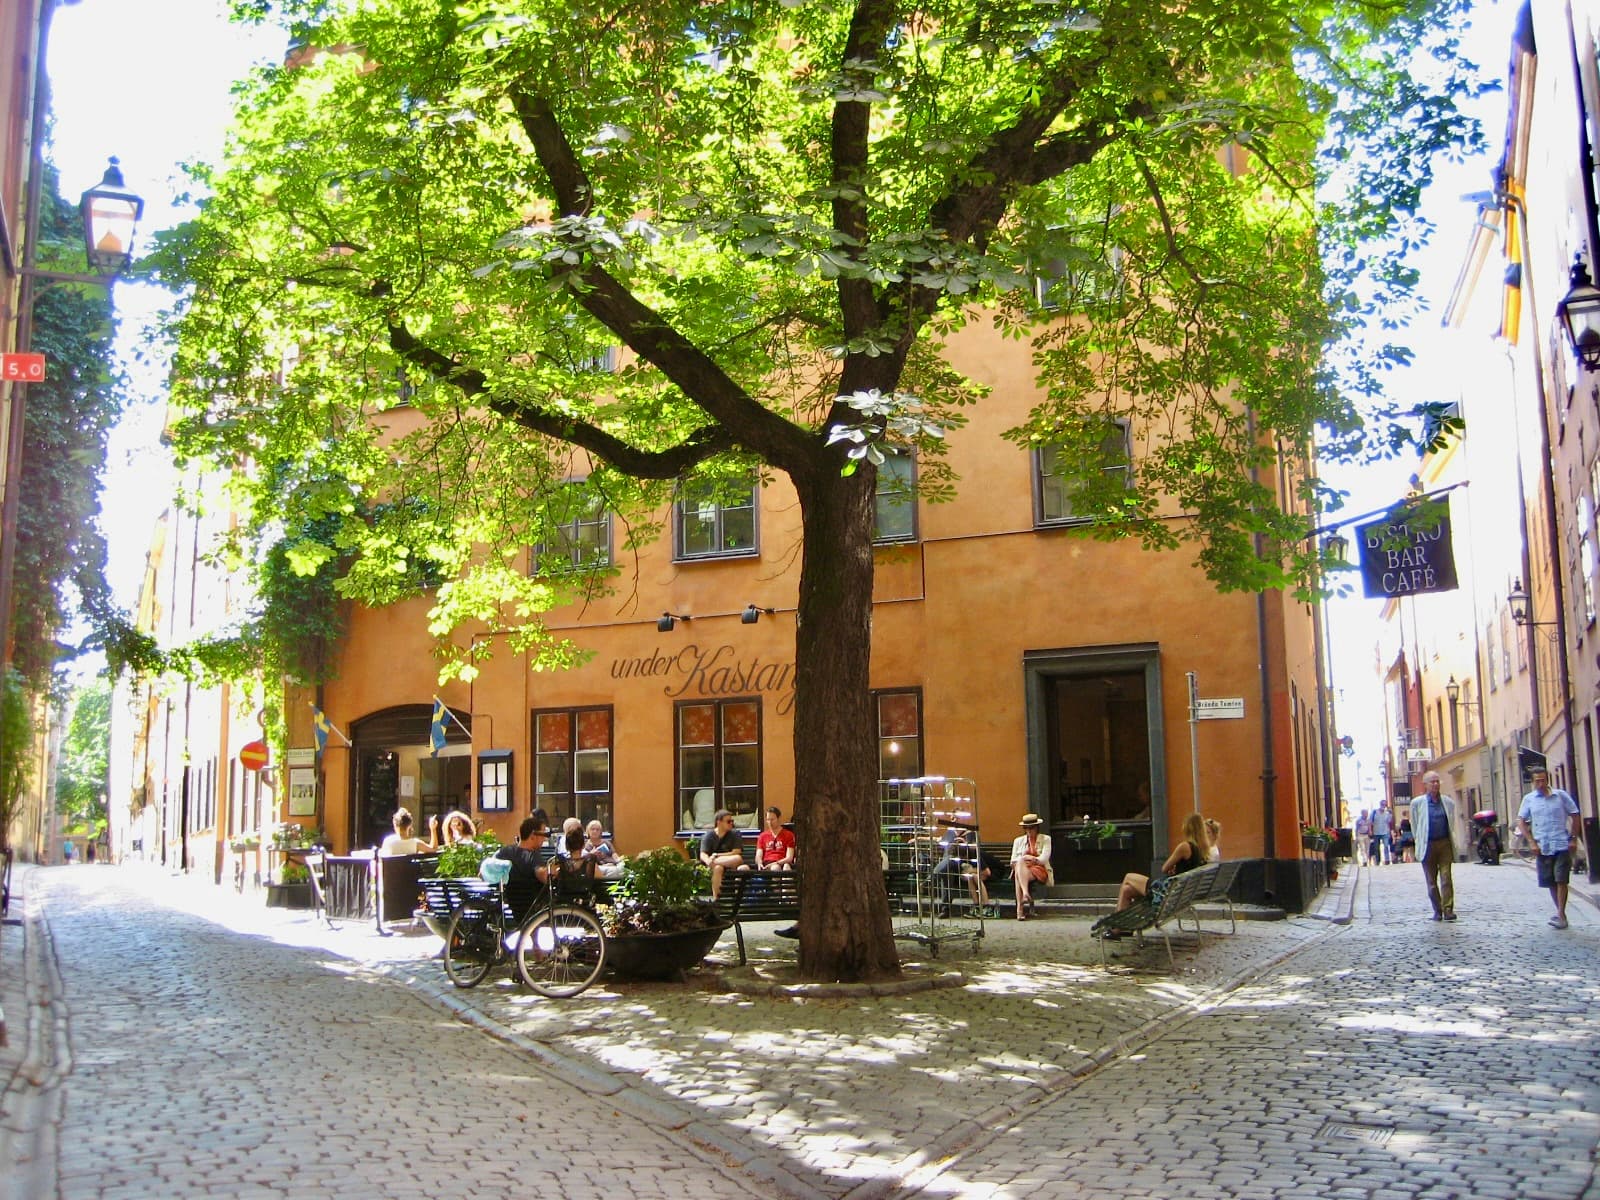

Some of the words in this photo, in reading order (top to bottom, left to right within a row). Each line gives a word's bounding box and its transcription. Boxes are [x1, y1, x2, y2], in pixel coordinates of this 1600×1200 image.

[1366, 521, 1442, 549] BSTRO
[1386, 545, 1428, 569] BAR
[1382, 564, 1437, 593] CAFÉ
[610, 647, 678, 679] under
